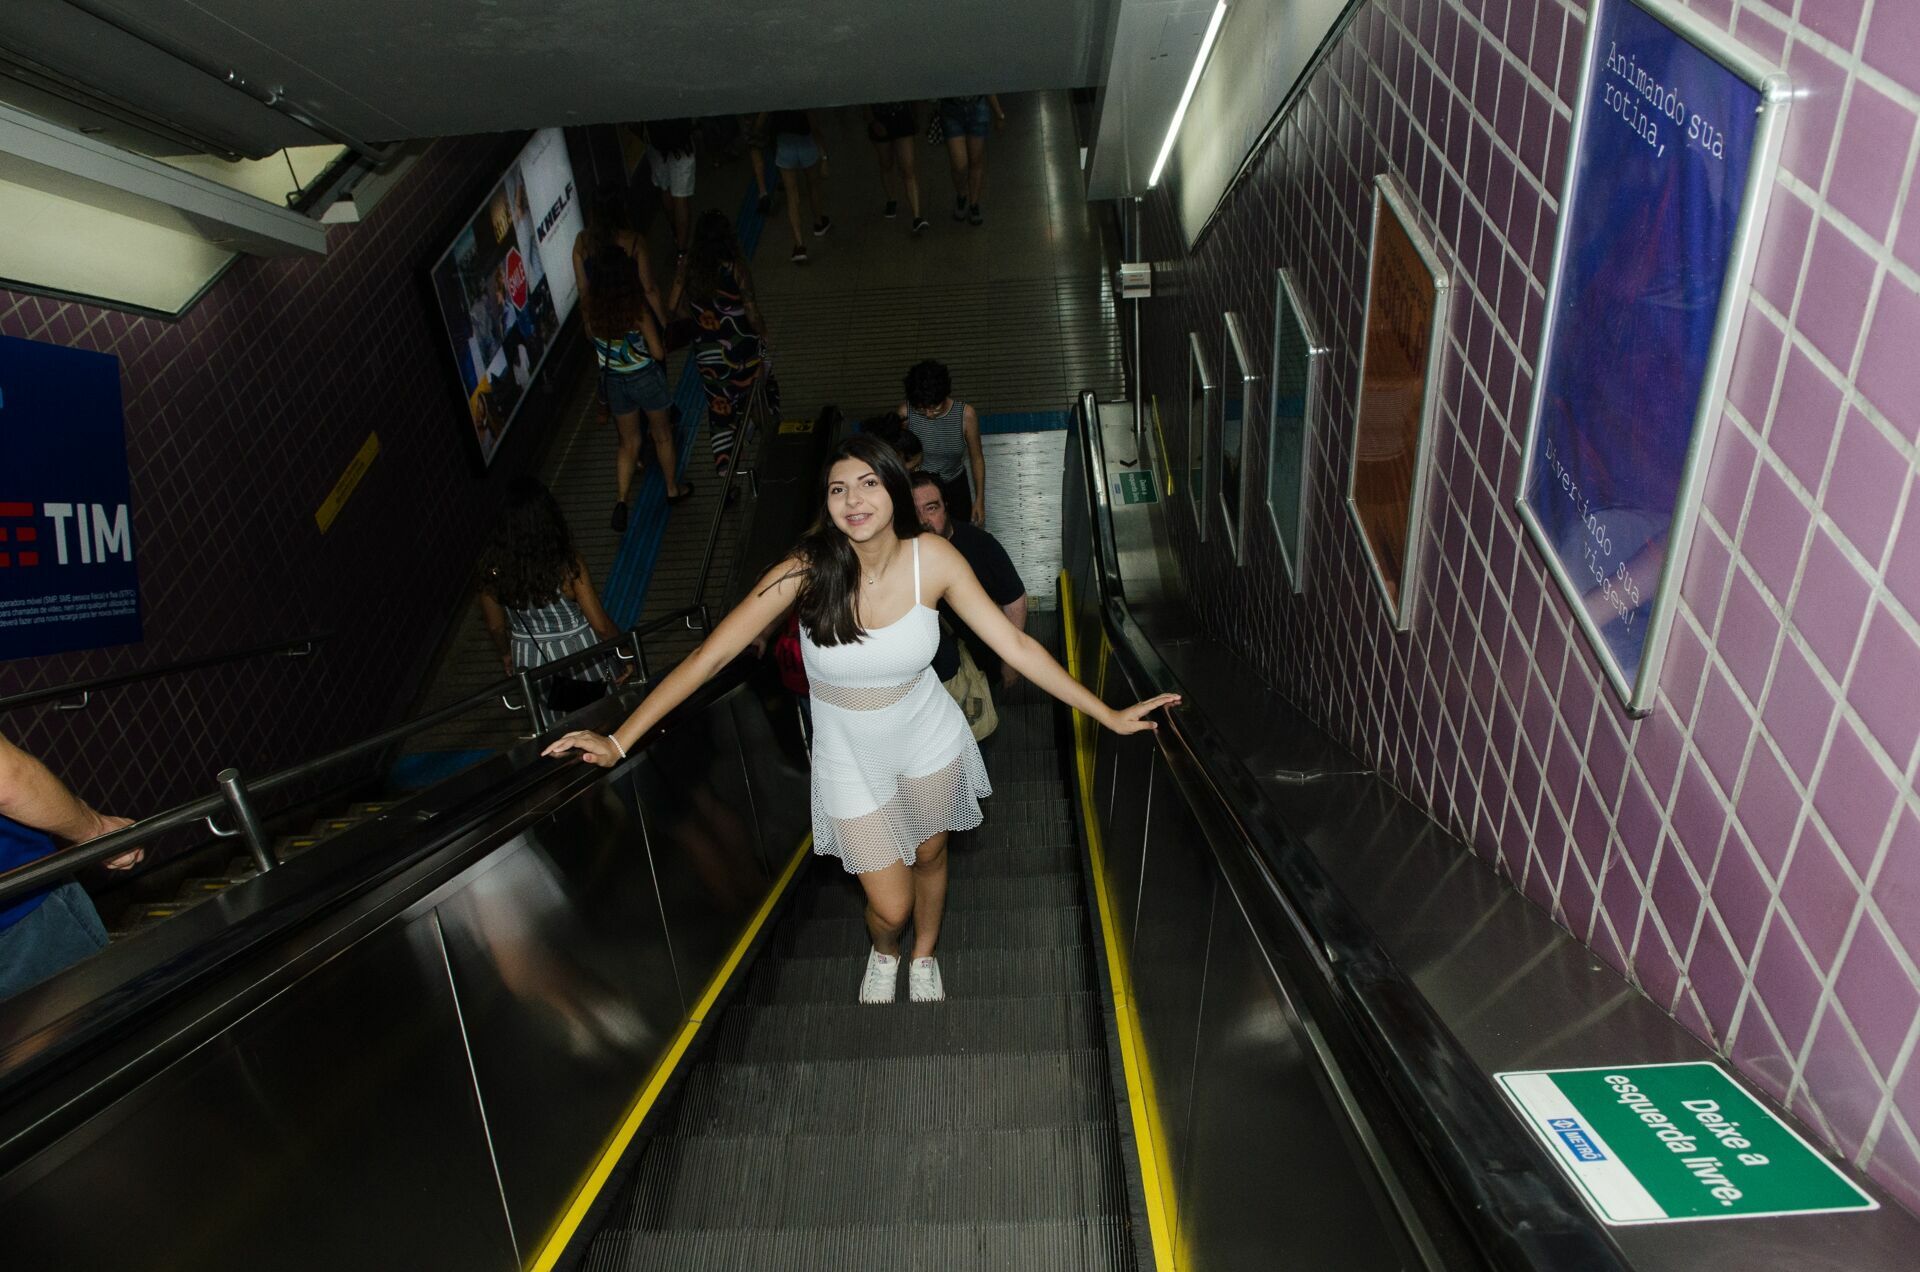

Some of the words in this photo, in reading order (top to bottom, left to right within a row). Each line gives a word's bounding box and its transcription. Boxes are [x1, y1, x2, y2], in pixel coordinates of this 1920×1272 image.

[1604, 82, 1665, 158] rotina,
[1606, 41, 1685, 126] Animando
[1687, 114, 1723, 160] sua
[537, 181, 573, 243] KHELF
[43, 502, 132, 565] TIM
[1545, 437, 1611, 556] Divertindo
[1617, 561, 1640, 608] sua
[1584, 541, 1635, 633] viagem!
[1564, 1131, 1602, 1160] METRÔ
[1604, 1075, 1697, 1153] esquerda
[1681, 1157, 1743, 1207] livre.
[1681, 1099, 1751, 1149] Deixe
[1737, 1153, 1770, 1166] a
